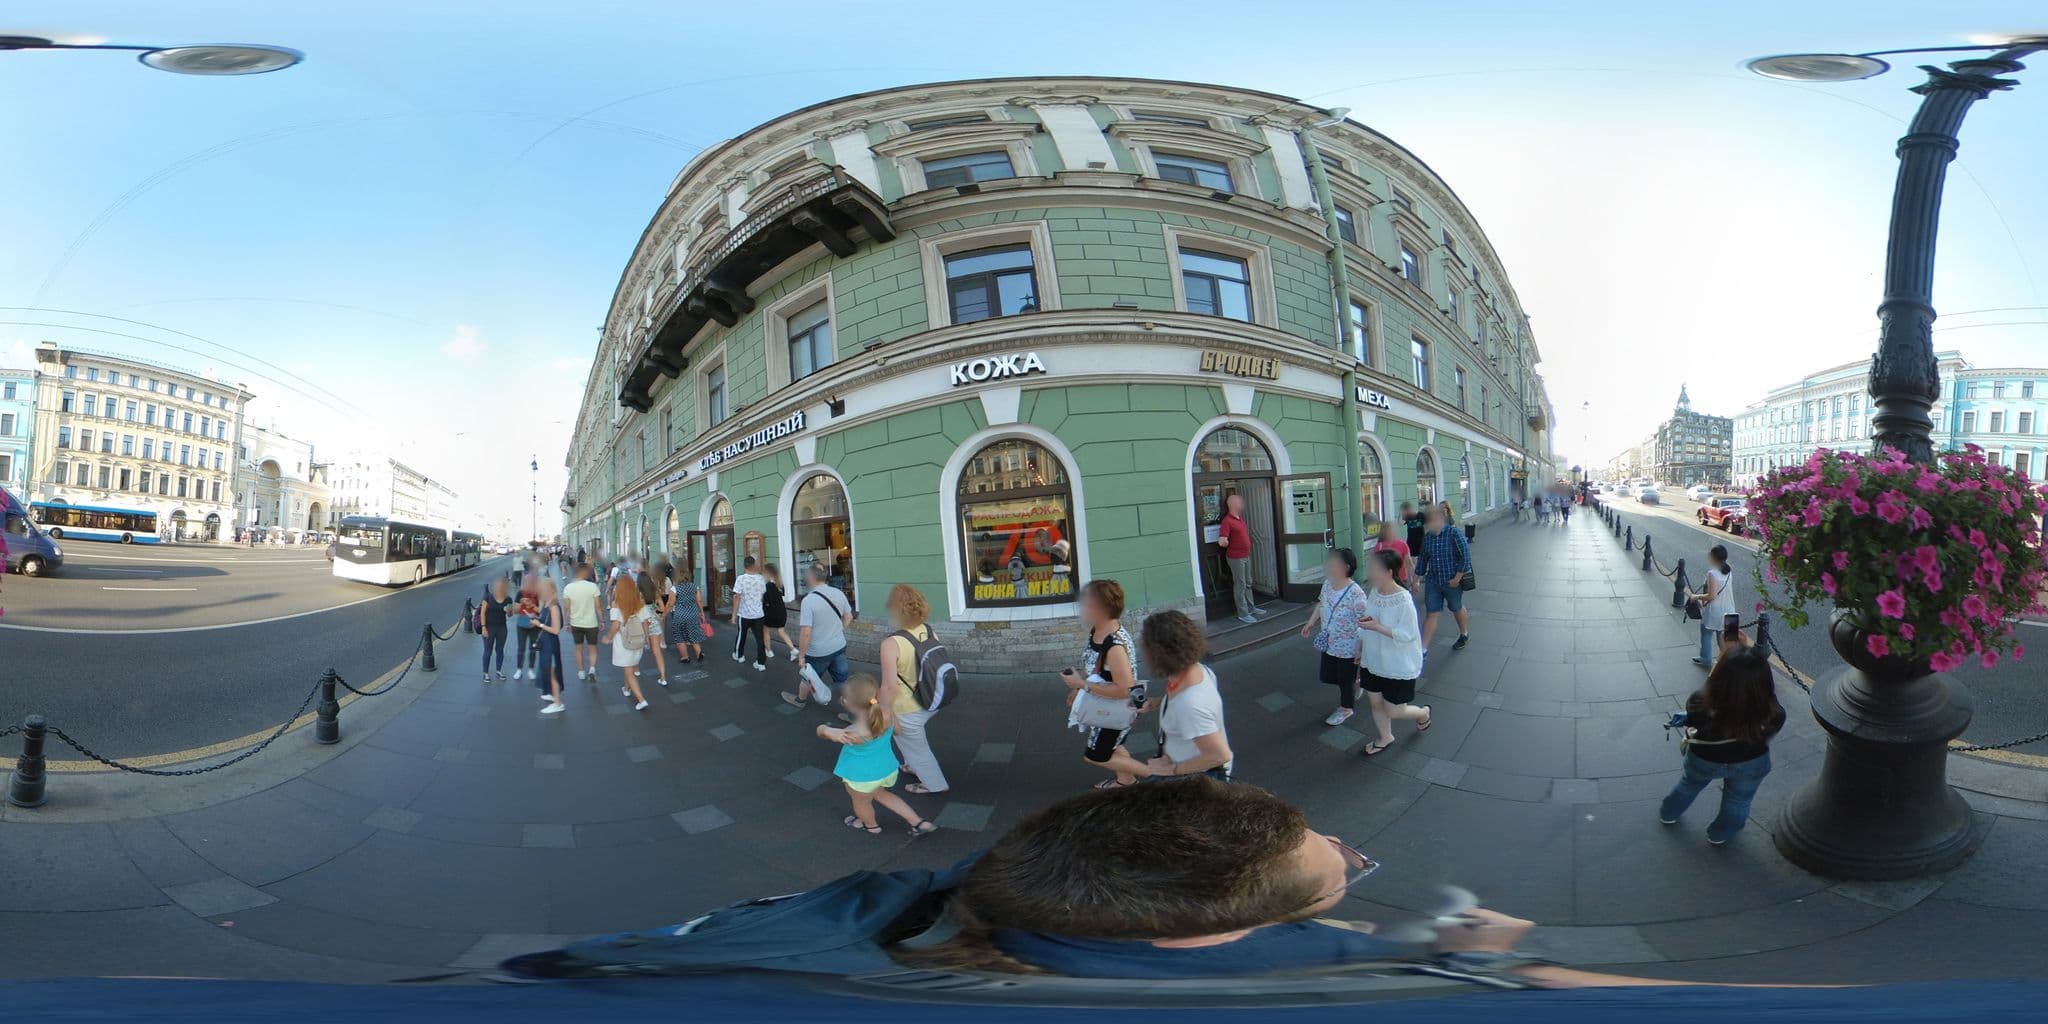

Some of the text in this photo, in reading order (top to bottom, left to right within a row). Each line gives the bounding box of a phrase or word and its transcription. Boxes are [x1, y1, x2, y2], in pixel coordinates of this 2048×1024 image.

[951, 352, 1046, 385] КОЖА
[1200, 350, 1280, 379] БРОДВЕЙ
[1356, 386, 1391, 410] МЕХА
[723, 410, 805, 459] НАСУЩНЫЙ
